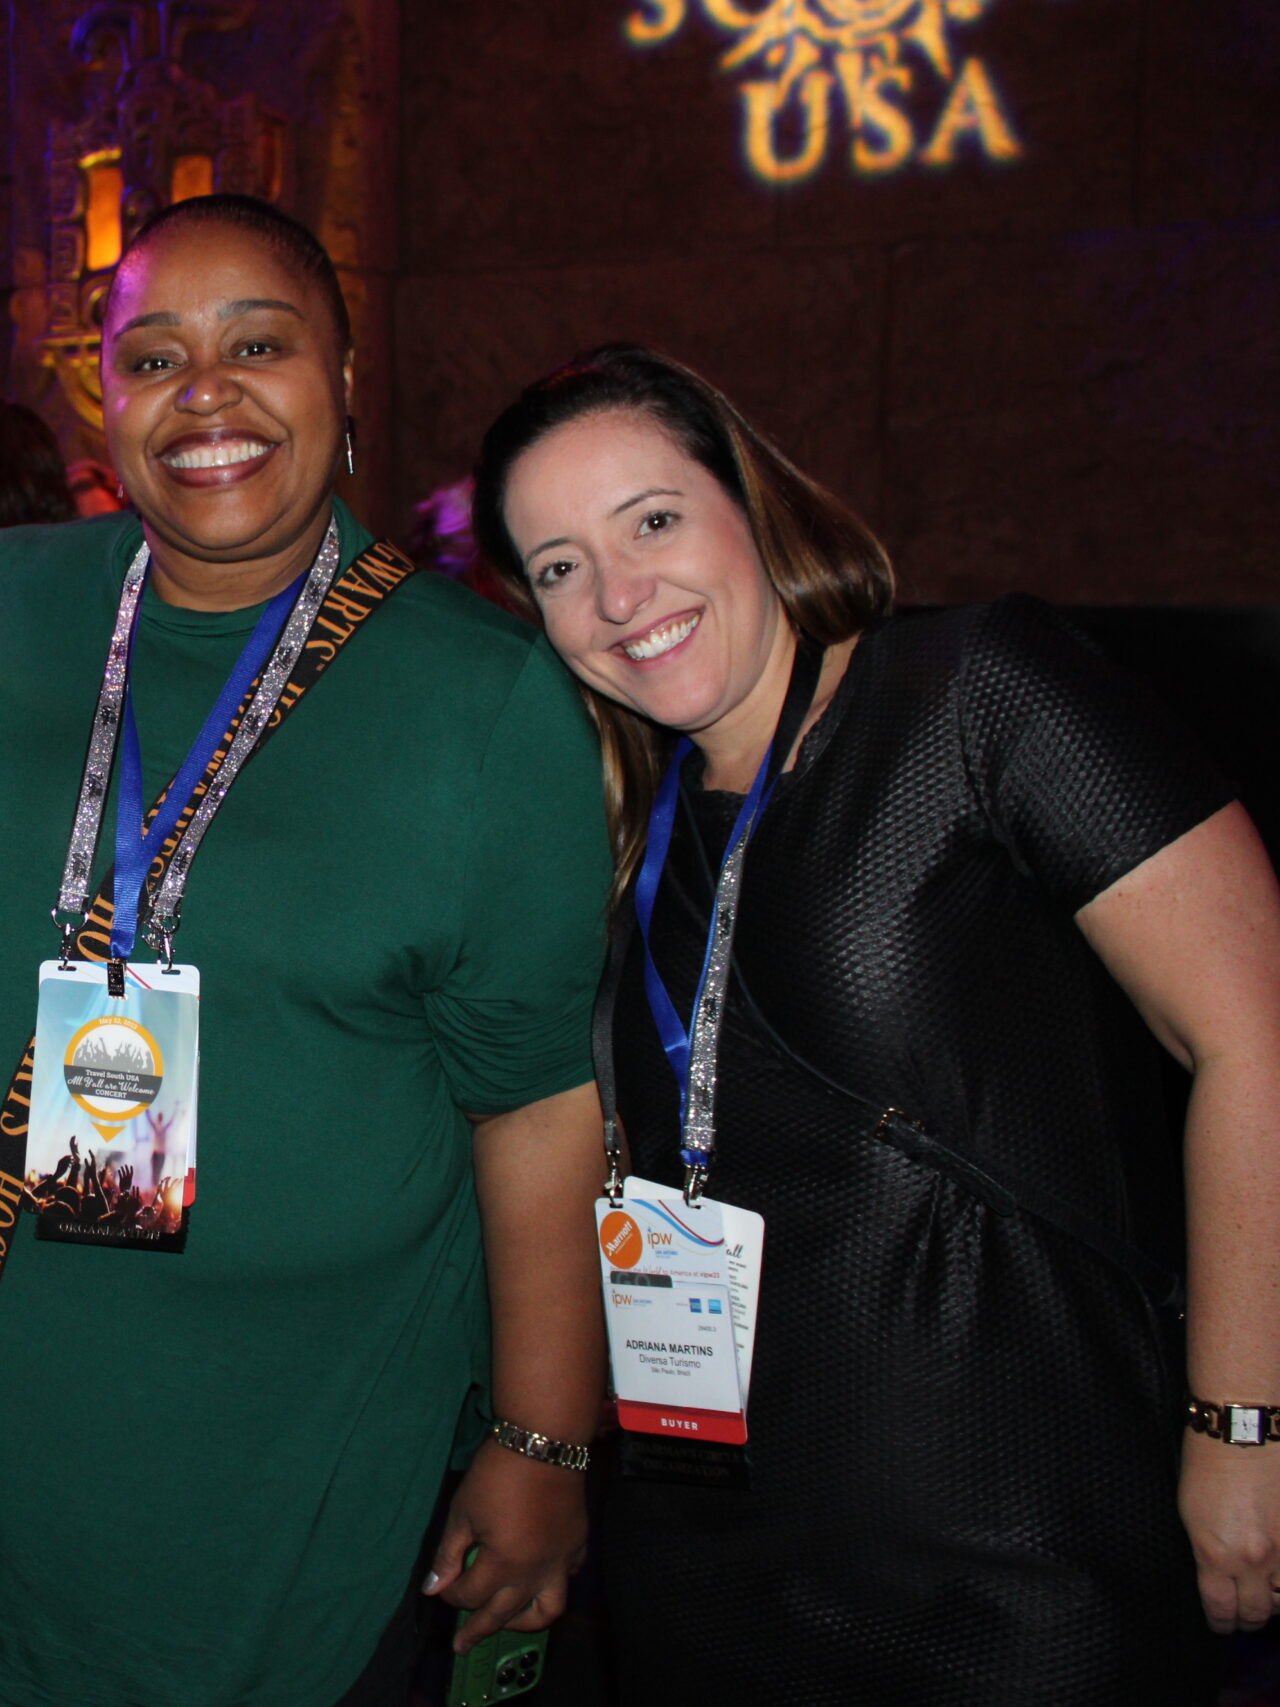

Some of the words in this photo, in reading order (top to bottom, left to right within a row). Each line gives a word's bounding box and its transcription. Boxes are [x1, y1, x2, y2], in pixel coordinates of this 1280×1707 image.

[741, 58, 1020, 180] USA
[85, 1069, 105, 1078] Travel
[106, 1072, 124, 1080] South
[126, 1074, 140, 1082] USA
[67, 1075, 82, 1086] All
[118, 1082, 155, 1096] Welcome
[95, 1088, 128, 1099] CONCERT
[58, 1223, 161, 1240] ORGANIZATION
[605, 1220, 633, 1257] Marriott
[647, 1229, 672, 1249] ipw
[612, 1291, 633, 1308] ipw
[626, 1339, 667, 1353] ADRIANA
[669, 1343, 713, 1357] MARTINS
[639, 1353, 668, 1366] Diversa
[670, 1357, 701, 1369] Turismo
[660, 1418, 699, 1431] BUYER
